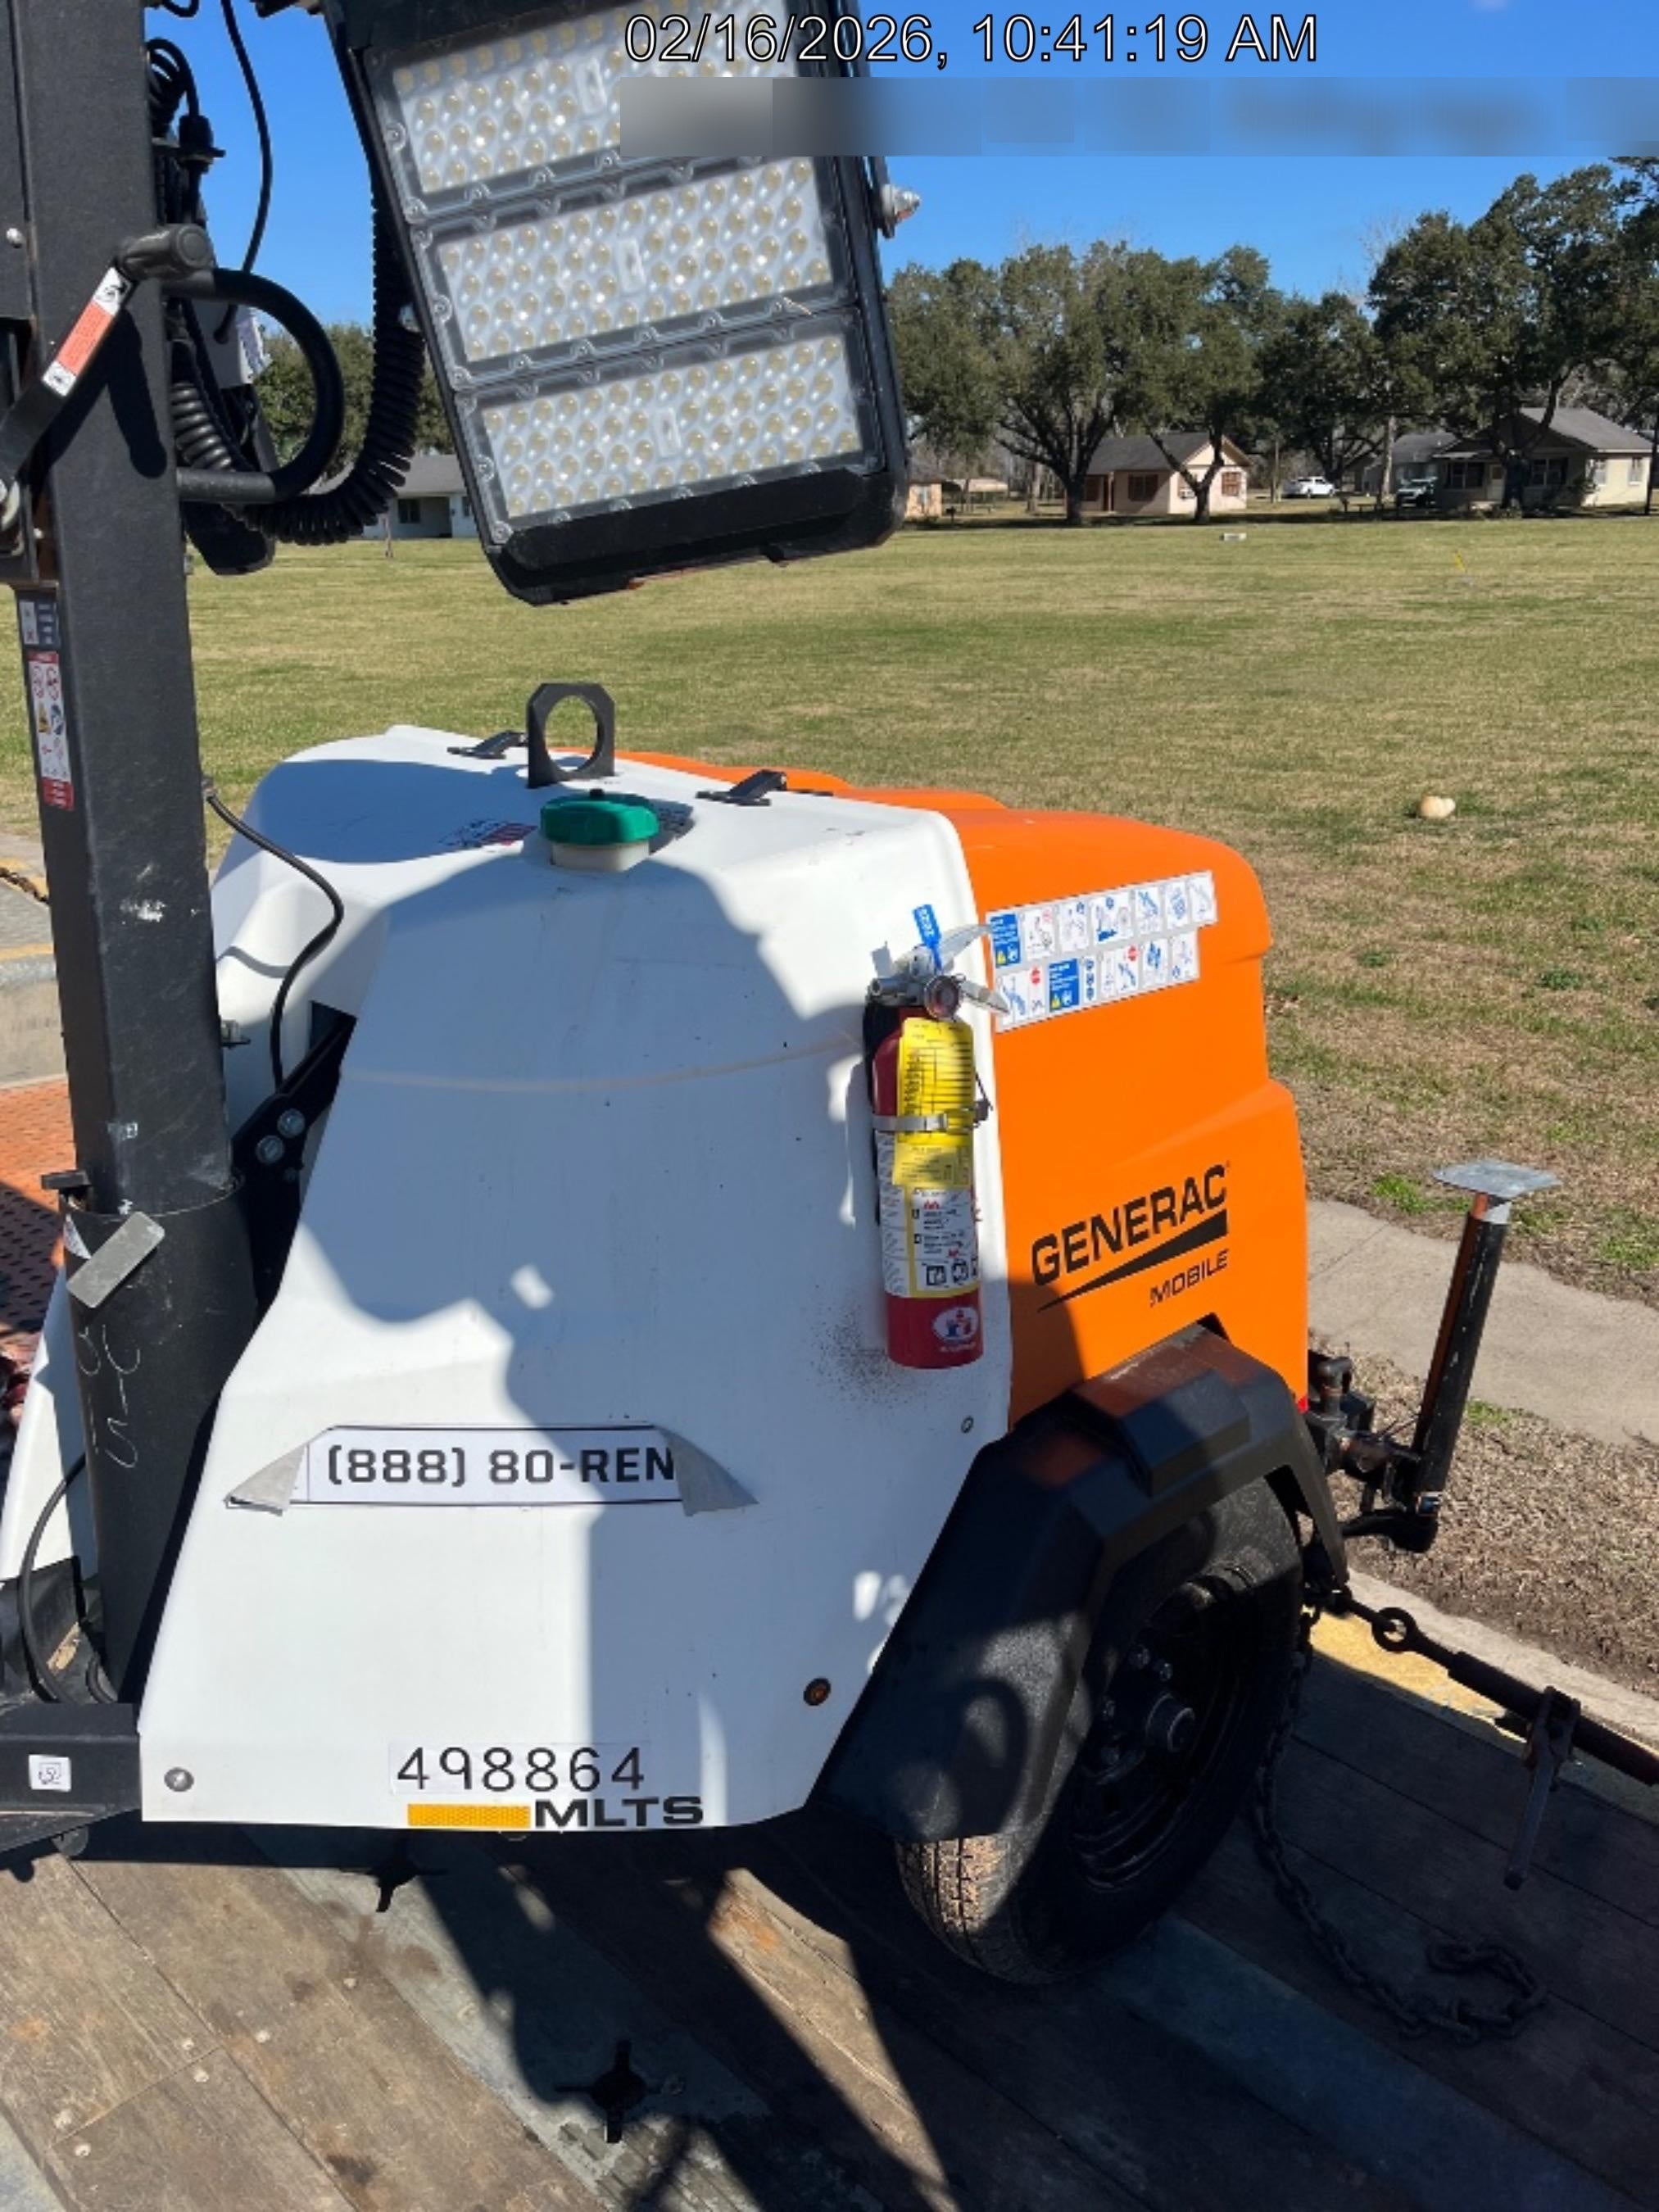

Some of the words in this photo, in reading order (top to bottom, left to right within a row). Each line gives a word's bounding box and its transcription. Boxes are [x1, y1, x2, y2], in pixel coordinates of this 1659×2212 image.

[1031, 1164, 1227, 1286] GENERAC
[1149, 1248, 1229, 1308] MOBILE
[329, 1444, 465, 1487] (888)
[397, 1747, 646, 1793] 498864
[535, 1796, 704, 1828] MLTS
